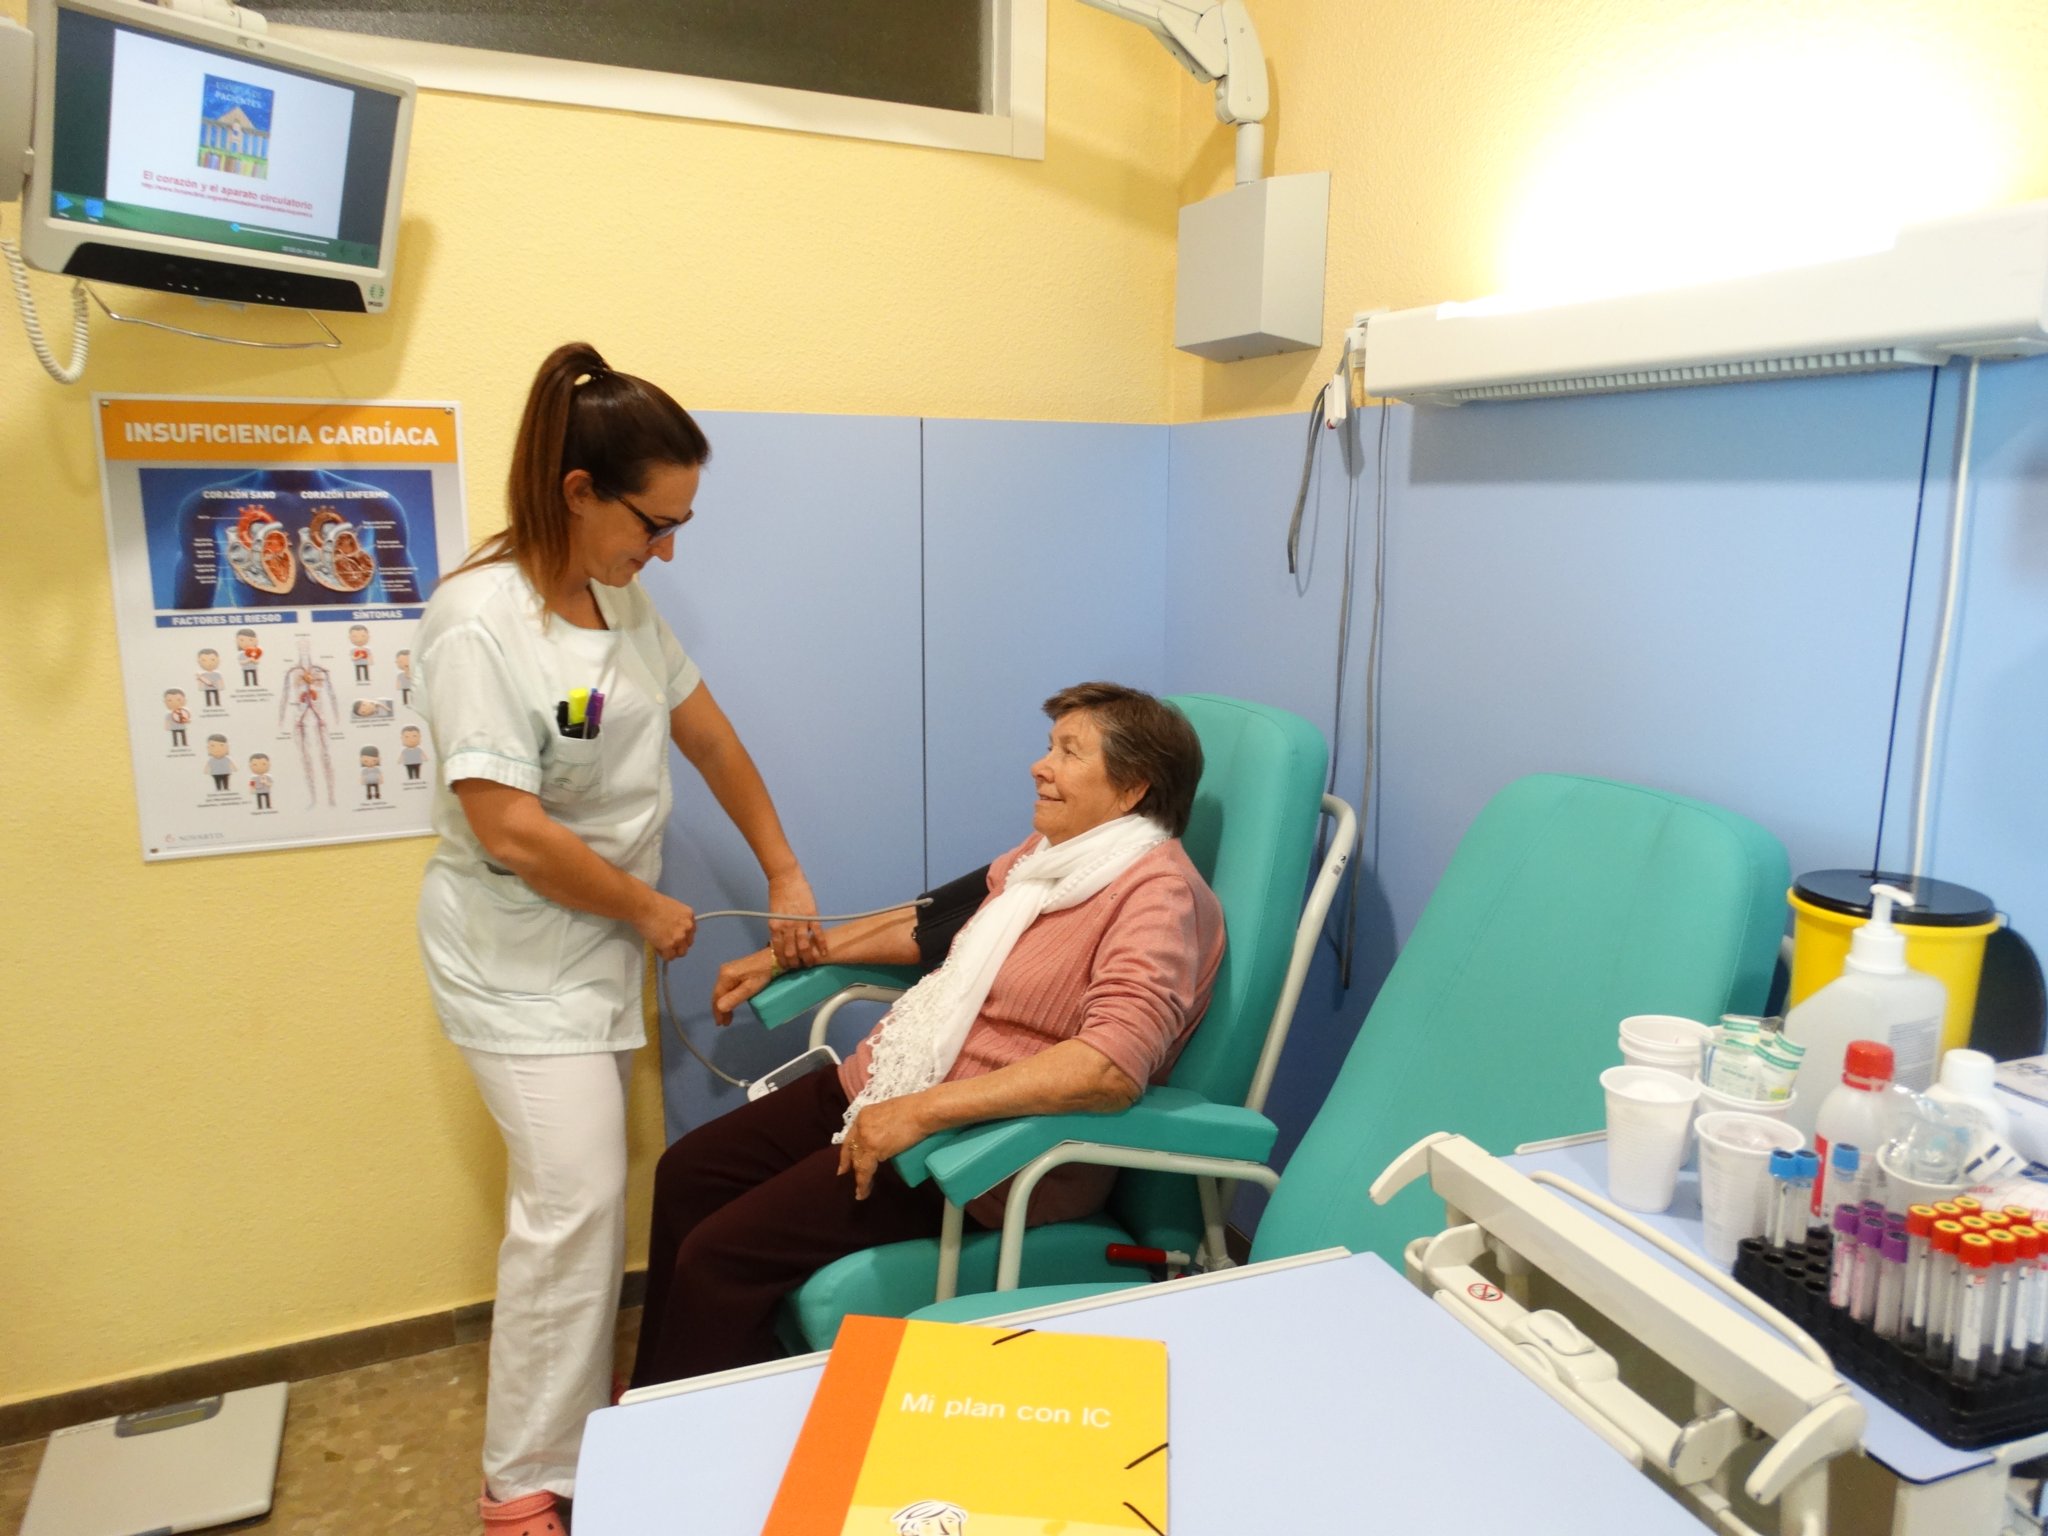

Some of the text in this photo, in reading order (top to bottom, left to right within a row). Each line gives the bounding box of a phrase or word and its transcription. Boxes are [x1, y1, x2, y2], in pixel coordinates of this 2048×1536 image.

[214, 90, 262, 108] PACIENTES
[143, 170, 313, 210] El corazón y el aparato circulatorio
[124, 420, 440, 446] INSUFICIENCIA CARDÍACA
[202, 488, 277, 499] CORAZÓN SANO
[300, 488, 390, 499] CORAZÓN ENFERMO
[172, 613, 282, 626] FACTORES DE RIESGO
[352, 609, 403, 620] SÍNTOMAS
[900, 1392, 1112, 1429] Mi plan con IC
